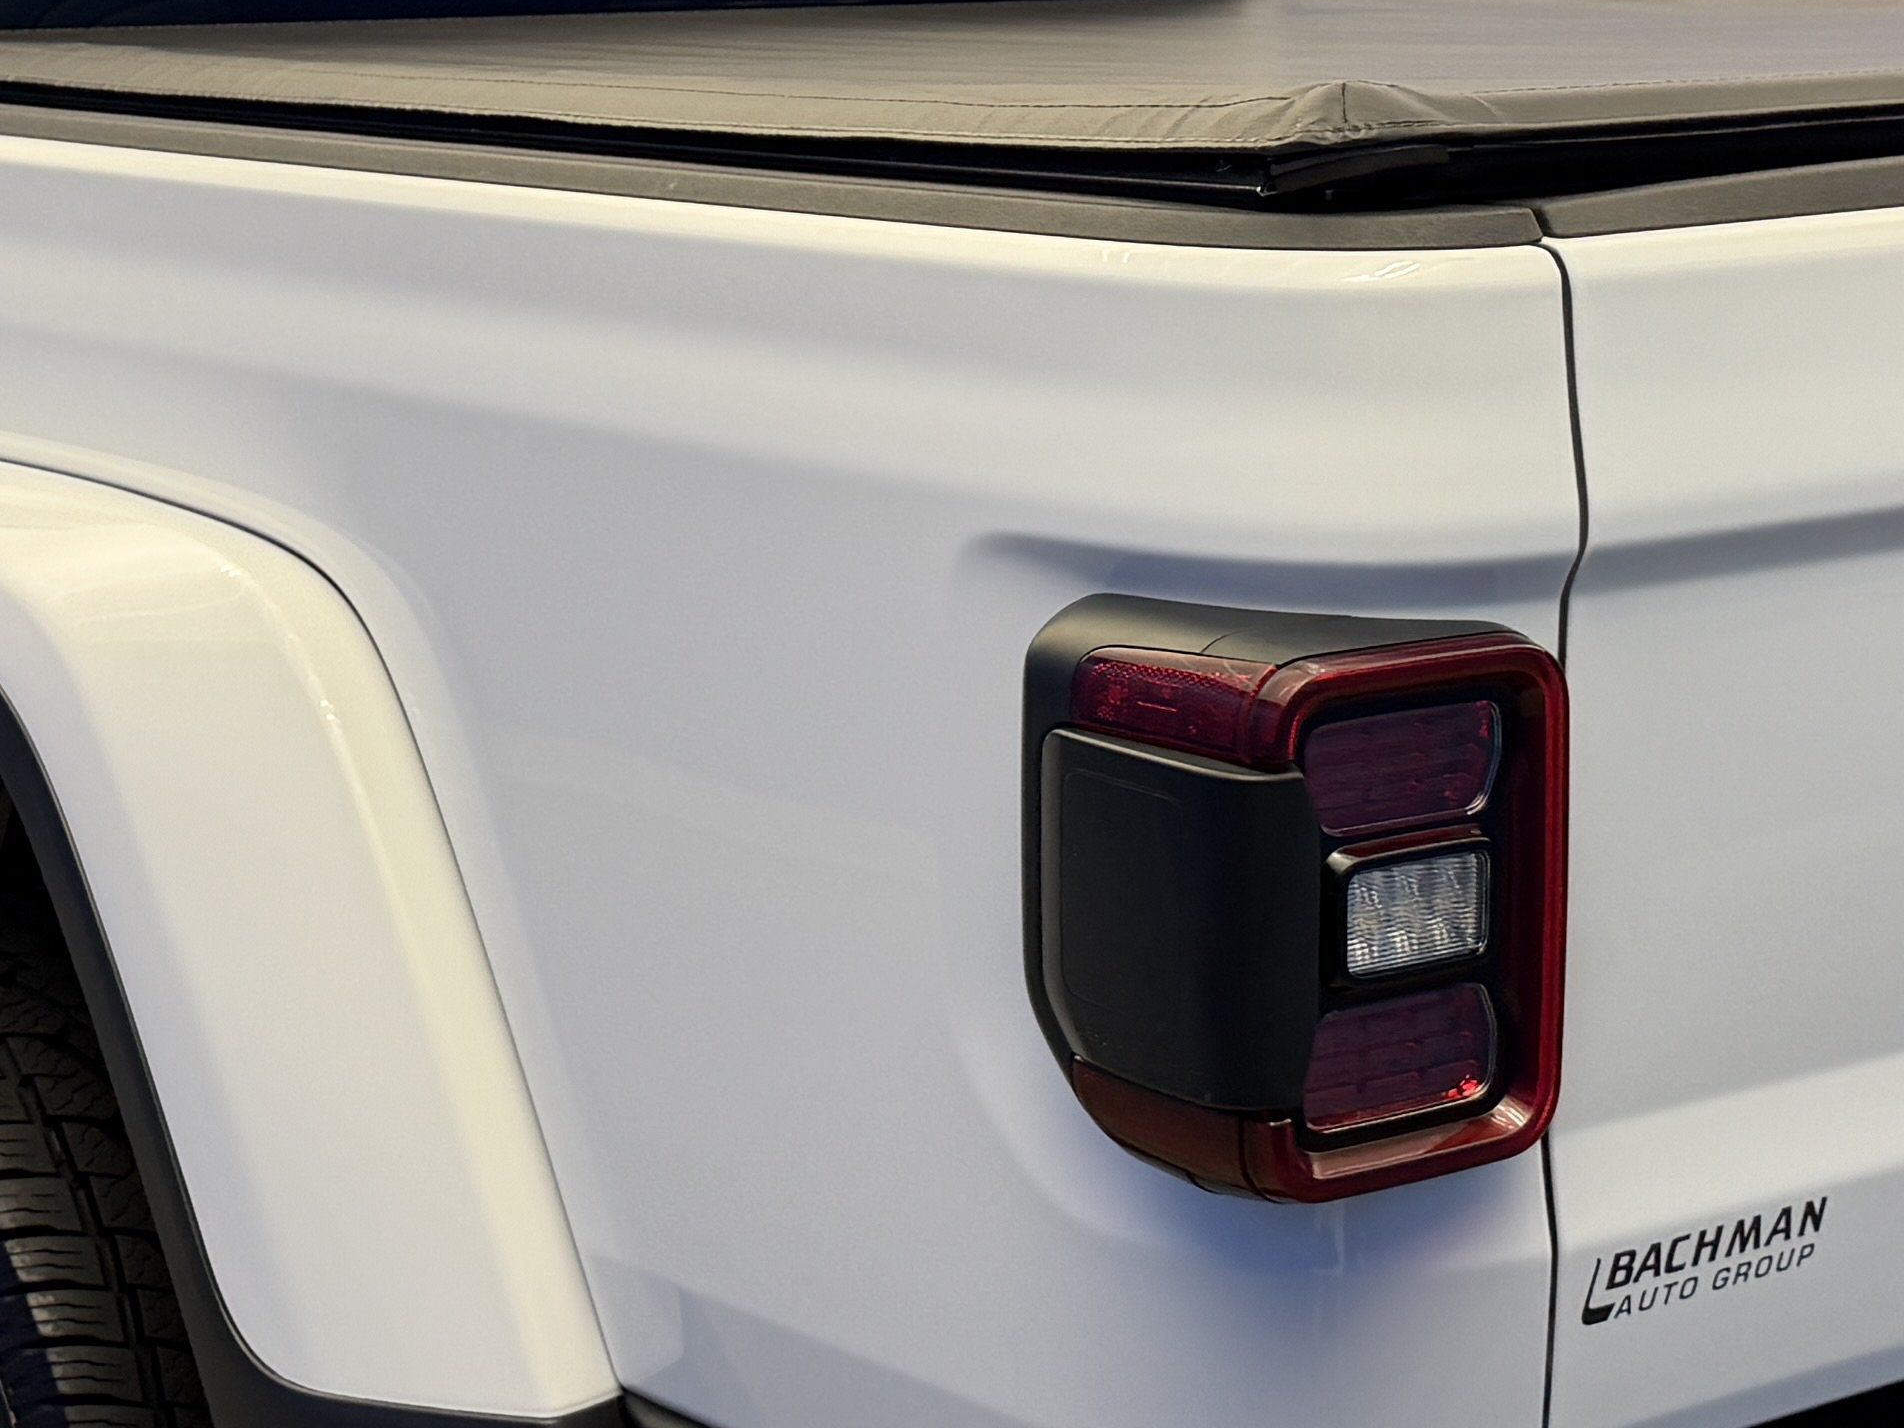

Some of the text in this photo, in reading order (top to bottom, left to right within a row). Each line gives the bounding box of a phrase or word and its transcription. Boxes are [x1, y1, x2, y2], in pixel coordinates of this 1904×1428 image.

[1606, 1196, 1828, 1290] BACHMAN
[1614, 1243, 1816, 1319] AUTO GROUP
